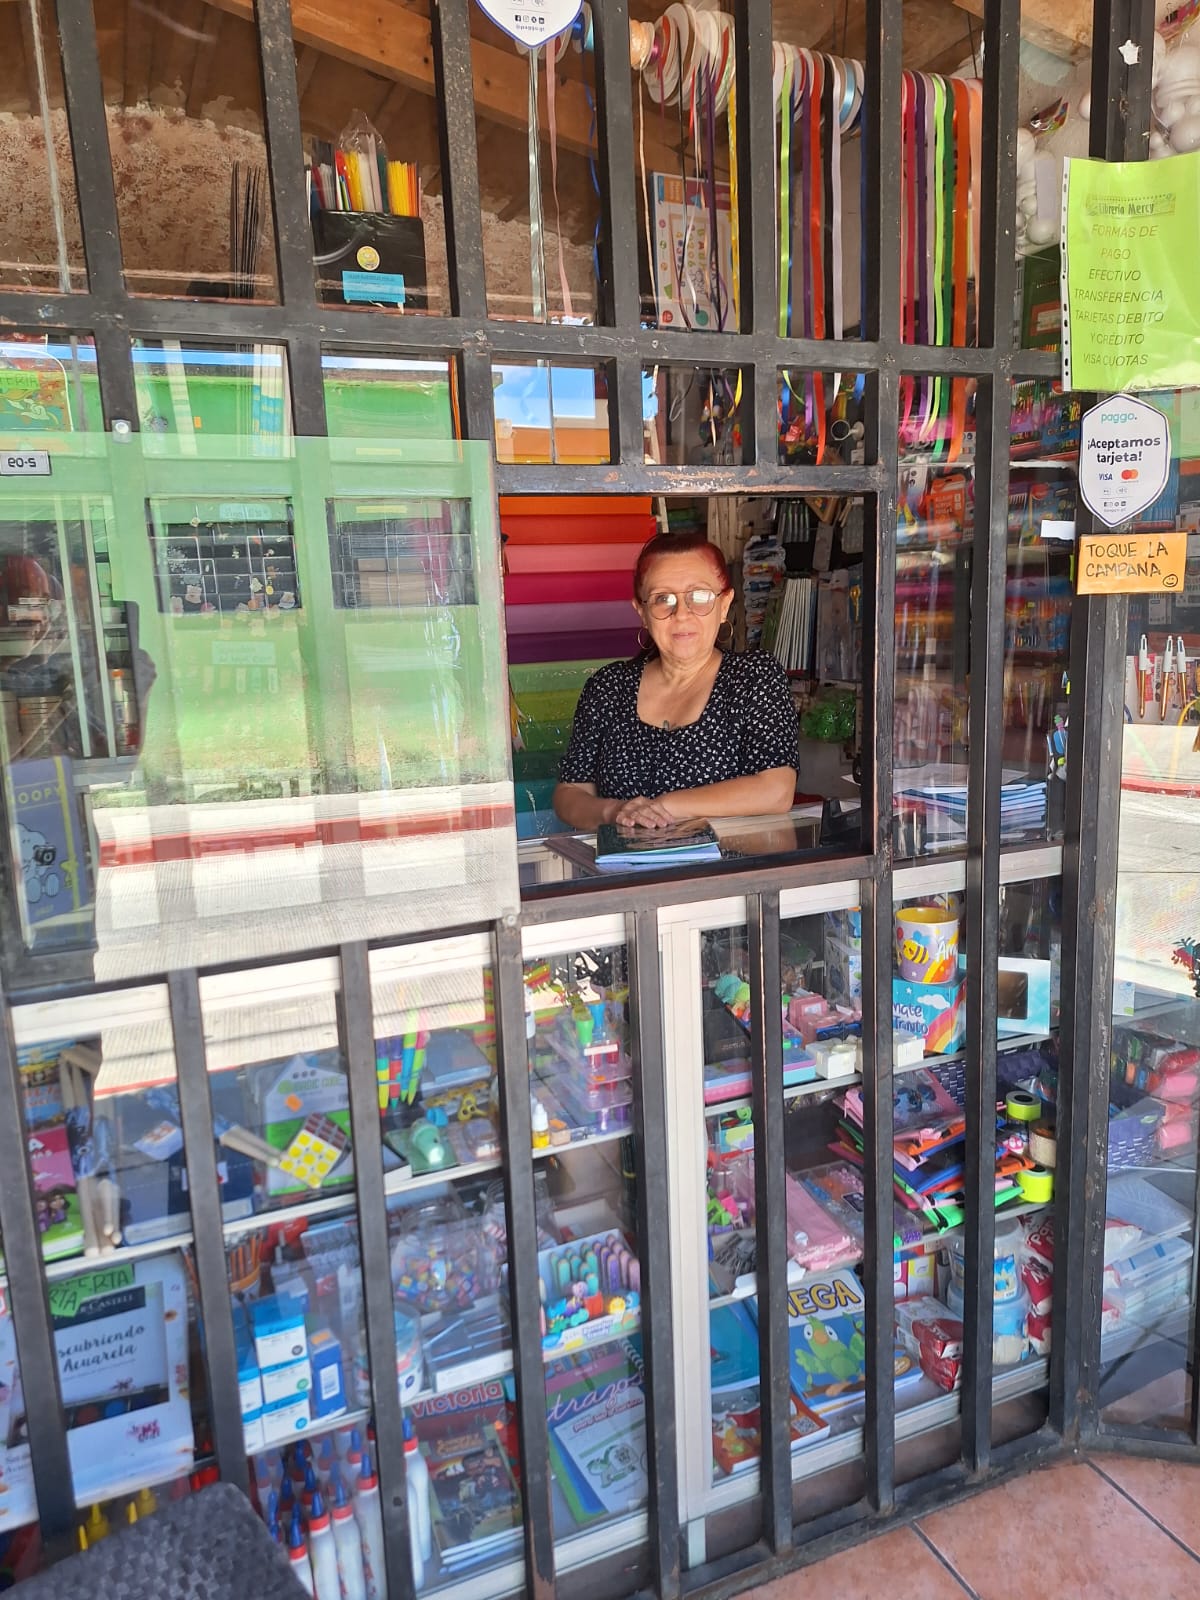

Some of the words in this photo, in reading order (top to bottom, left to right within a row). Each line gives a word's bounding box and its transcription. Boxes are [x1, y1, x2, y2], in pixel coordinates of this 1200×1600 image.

[1128, 203, 1154, 216] Mercy
[1092, 225, 1136, 238] FORMAS
[1139, 225, 1159, 237] DE
[1101, 248, 1131, 260] PAGO
[1089, 269, 1141, 281] EFECTIVO
[1075, 288, 1164, 302] TRANSFERENCIA
[1075, 309, 1114, 323] TARJETAS
[1117, 311, 1164, 324] DEBITO
[1090, 333, 1096, 343] Y
[1083, 353, 1101, 365] VISA
[1103, 354, 1148, 367] CUOTAS
[1087, 436, 1161, 451] ¡Aceptamos
[1096, 451, 1142, 465] tarjeta!
[1099, 473, 1113, 481] VISA
[1086, 542, 1137, 558] TOQUE
[1149, 541, 1169, 558] LA
[1085, 561, 1161, 578] CAMPANA
[58, 1324, 145, 1358] scubriendo
